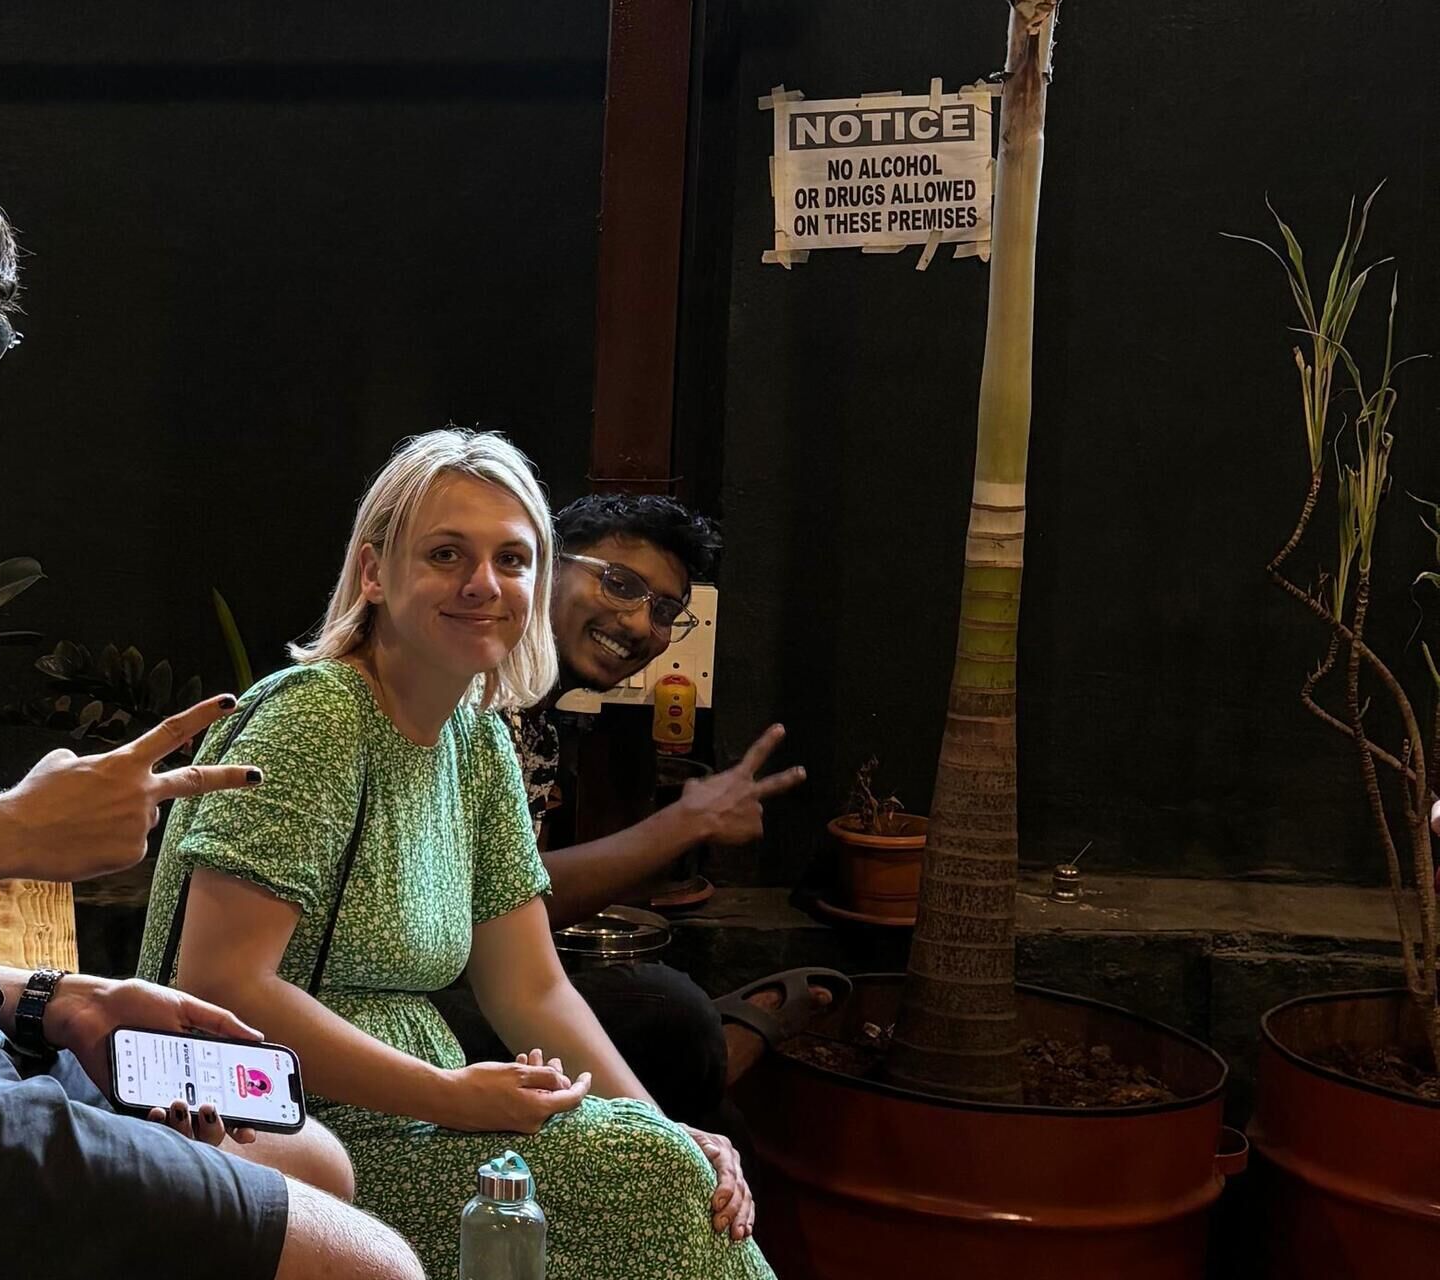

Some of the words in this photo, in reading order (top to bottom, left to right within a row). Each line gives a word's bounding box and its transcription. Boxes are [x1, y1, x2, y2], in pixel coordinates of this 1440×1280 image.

[795, 108, 970, 146] NOTICE
[827, 158, 853, 181] NO
[858, 154, 942, 179] ALCOHOL
[795, 188, 820, 210] OR
[825, 184, 886, 208] DRUGS
[890, 179, 976, 205] ALLOWED
[793, 214, 819, 237] ON
[824, 211, 882, 235] THESE
[887, 206, 978, 232] PREMISES
